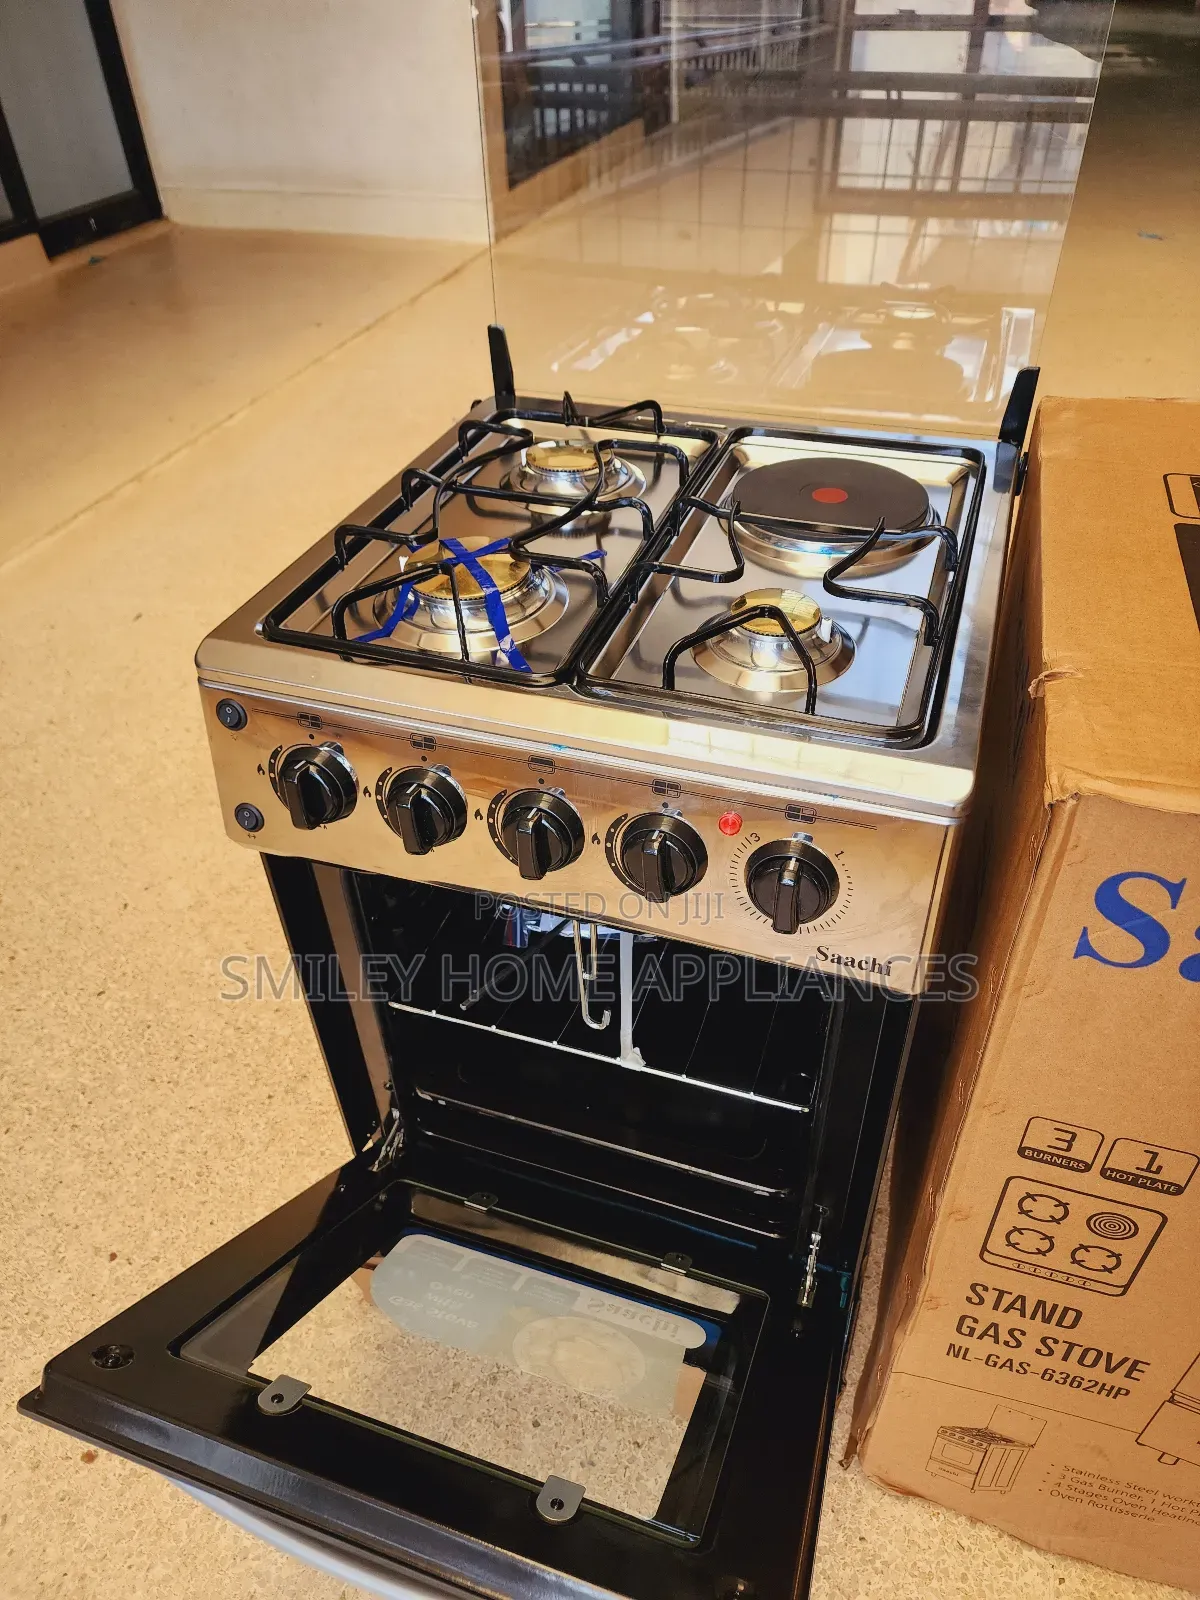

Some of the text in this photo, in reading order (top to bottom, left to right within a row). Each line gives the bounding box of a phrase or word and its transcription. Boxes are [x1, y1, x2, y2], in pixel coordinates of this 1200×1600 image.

[815, 945, 892, 977] Saachi
[1047, 1127, 1078, 1153] 3
[1024, 1149, 1086, 1170] BURNERS
[1135, 1149, 1163, 1175] 1
[1105, 1169, 1179, 1193] HOT PLATE
[965, 1282, 1083, 1330] STAND
[955, 1314, 1151, 1382] GAS STOVE
[946, 1343, 1131, 1400] NL-GAS-6362HP
[1062, 1465, 1121, 1486] Stainless
[1124, 1481, 1159, 1496] Steel
[1070, 1476, 1094, 1488] Gas
[1160, 1501, 1186, 1513] Hot
[1050, 1489, 1083, 1503] Oven
[1065, 1484, 1108, 1501] Stages
[1113, 1497, 1147, 1511] Oven
